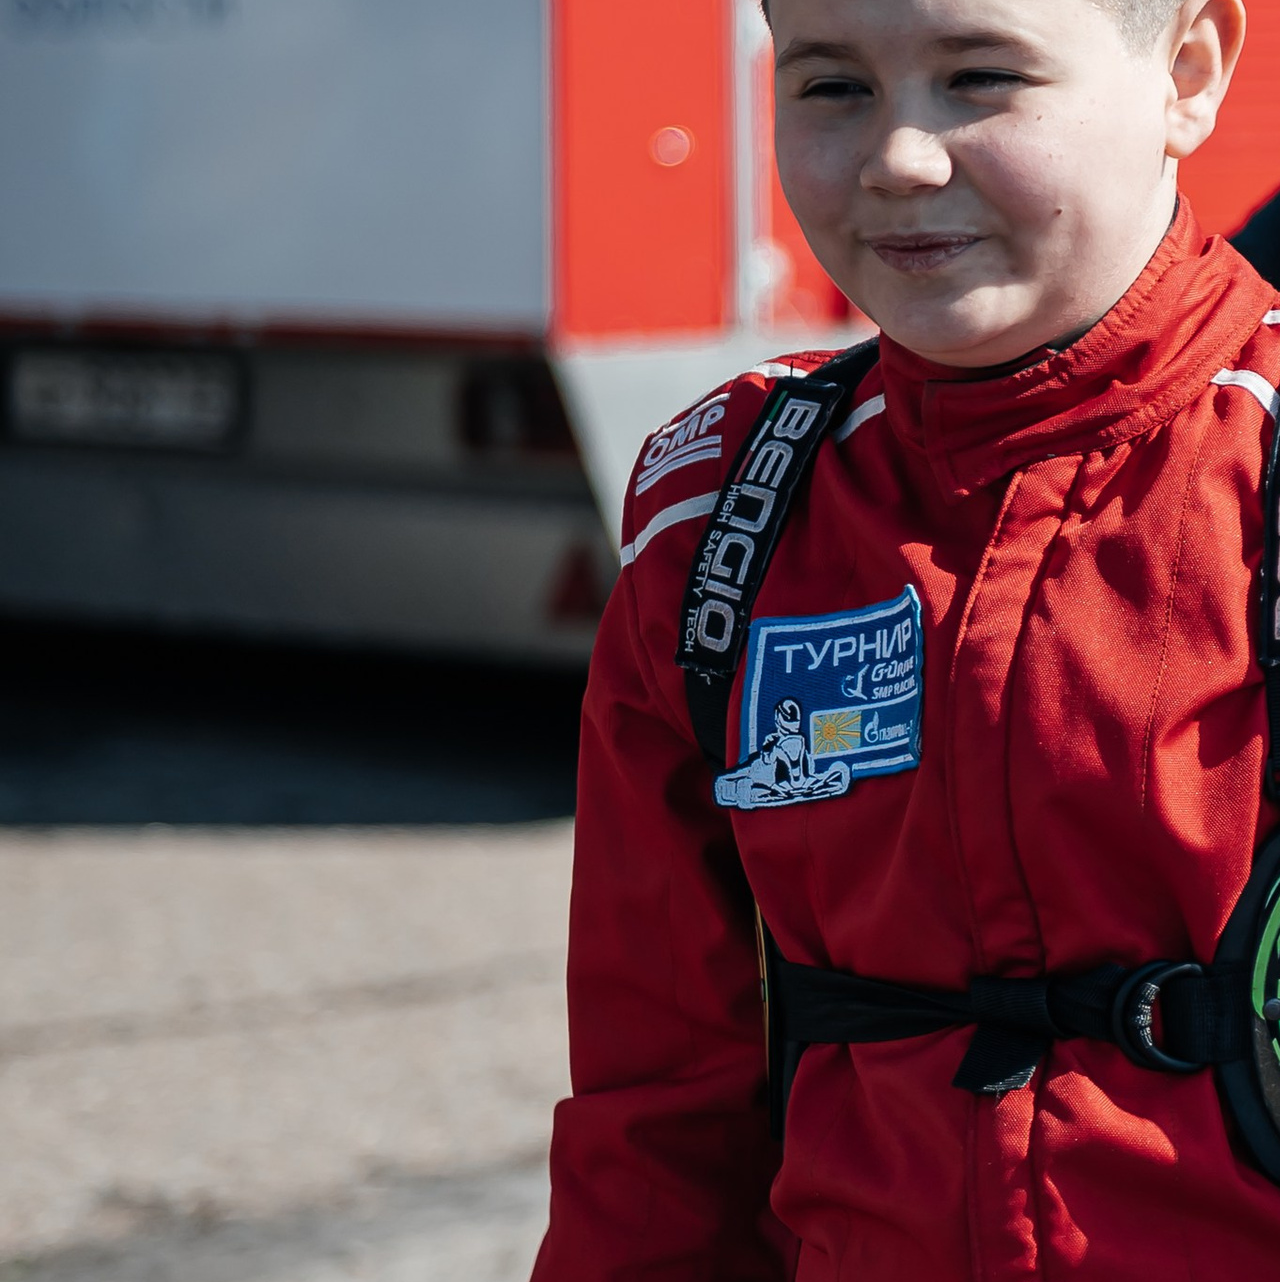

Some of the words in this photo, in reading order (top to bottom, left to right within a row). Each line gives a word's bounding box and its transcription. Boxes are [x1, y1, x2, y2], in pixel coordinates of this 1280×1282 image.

[644, 404, 725, 466] OMP
[697, 398, 822, 653] BENGIO
[716, 484, 741, 523] HIGH
[692, 529, 722, 598] SAFETY
[684, 606, 700, 653] TECH
[774, 618, 912, 674] ТУРНИР
